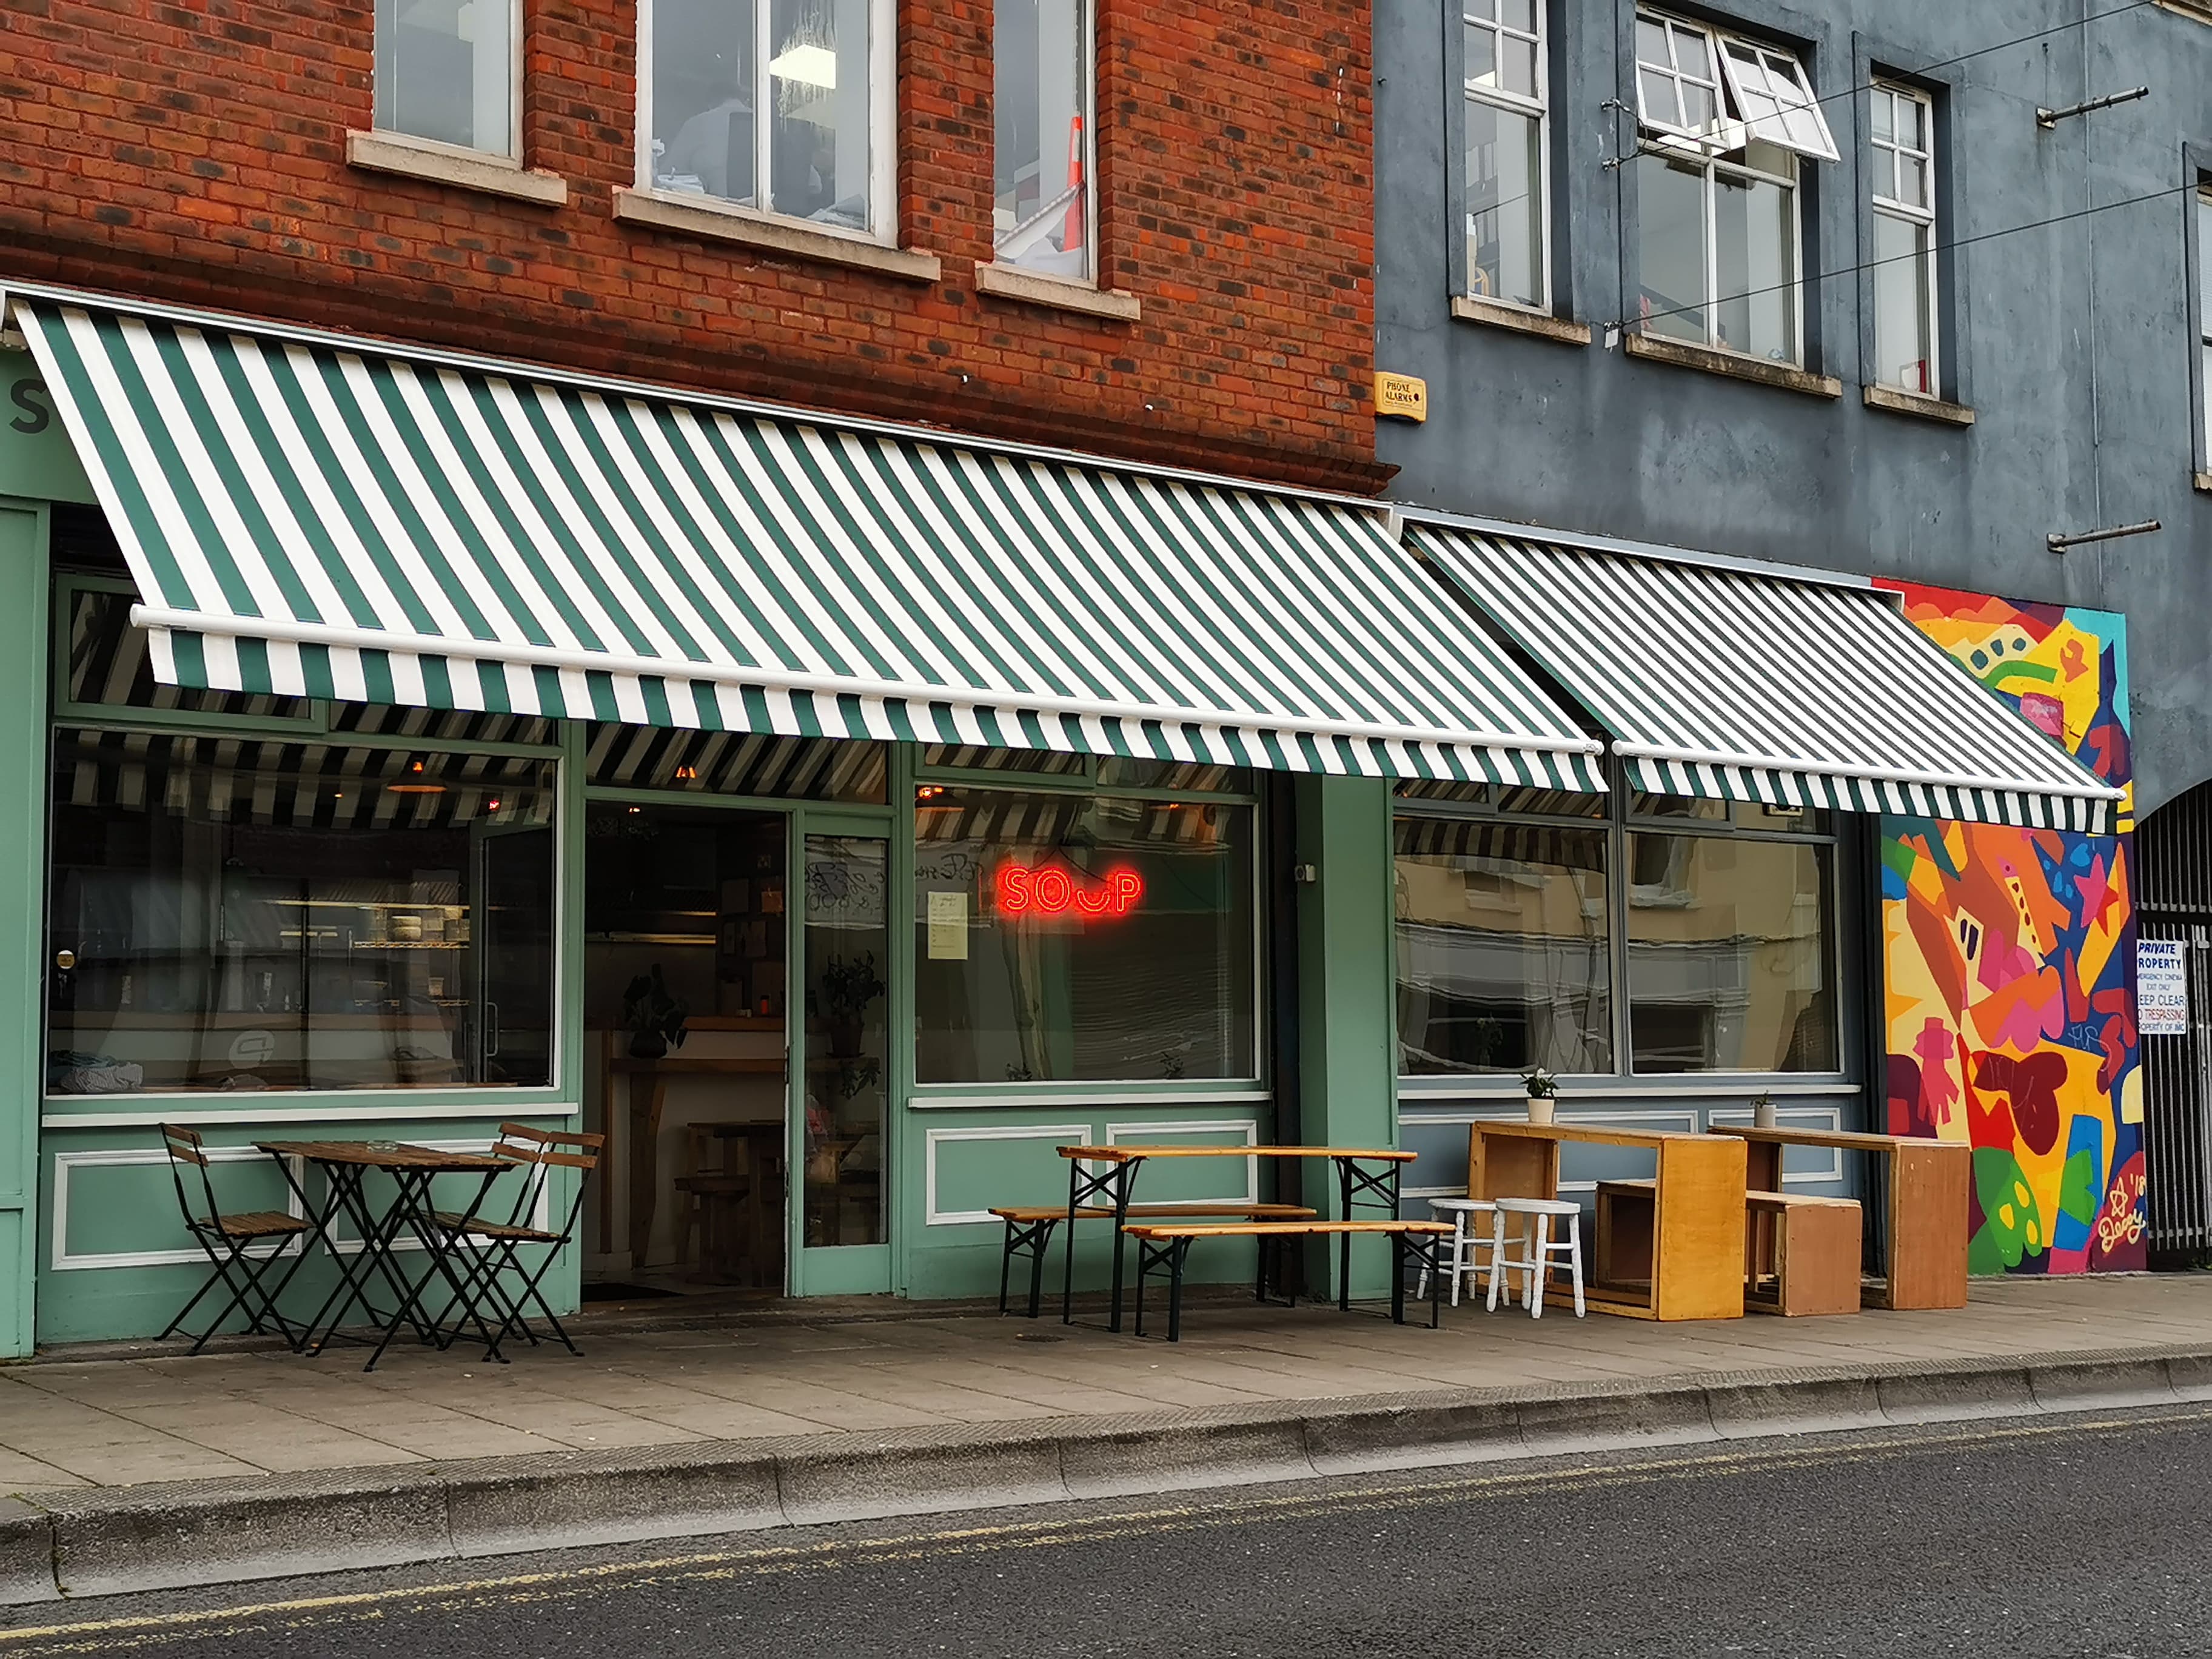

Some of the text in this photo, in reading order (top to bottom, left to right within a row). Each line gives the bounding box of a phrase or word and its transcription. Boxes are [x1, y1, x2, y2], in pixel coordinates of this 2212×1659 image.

[1387, 381, 1410, 393] PHONE
[1385, 391, 1412, 402] ALARMS
[1005, 867, 1141, 912] SOUP
[2138, 942, 2176, 954] PRIVATE
[2139, 957, 2182, 969] ROPERTY
[2139, 994, 2185, 1006] EEP CLEAR
